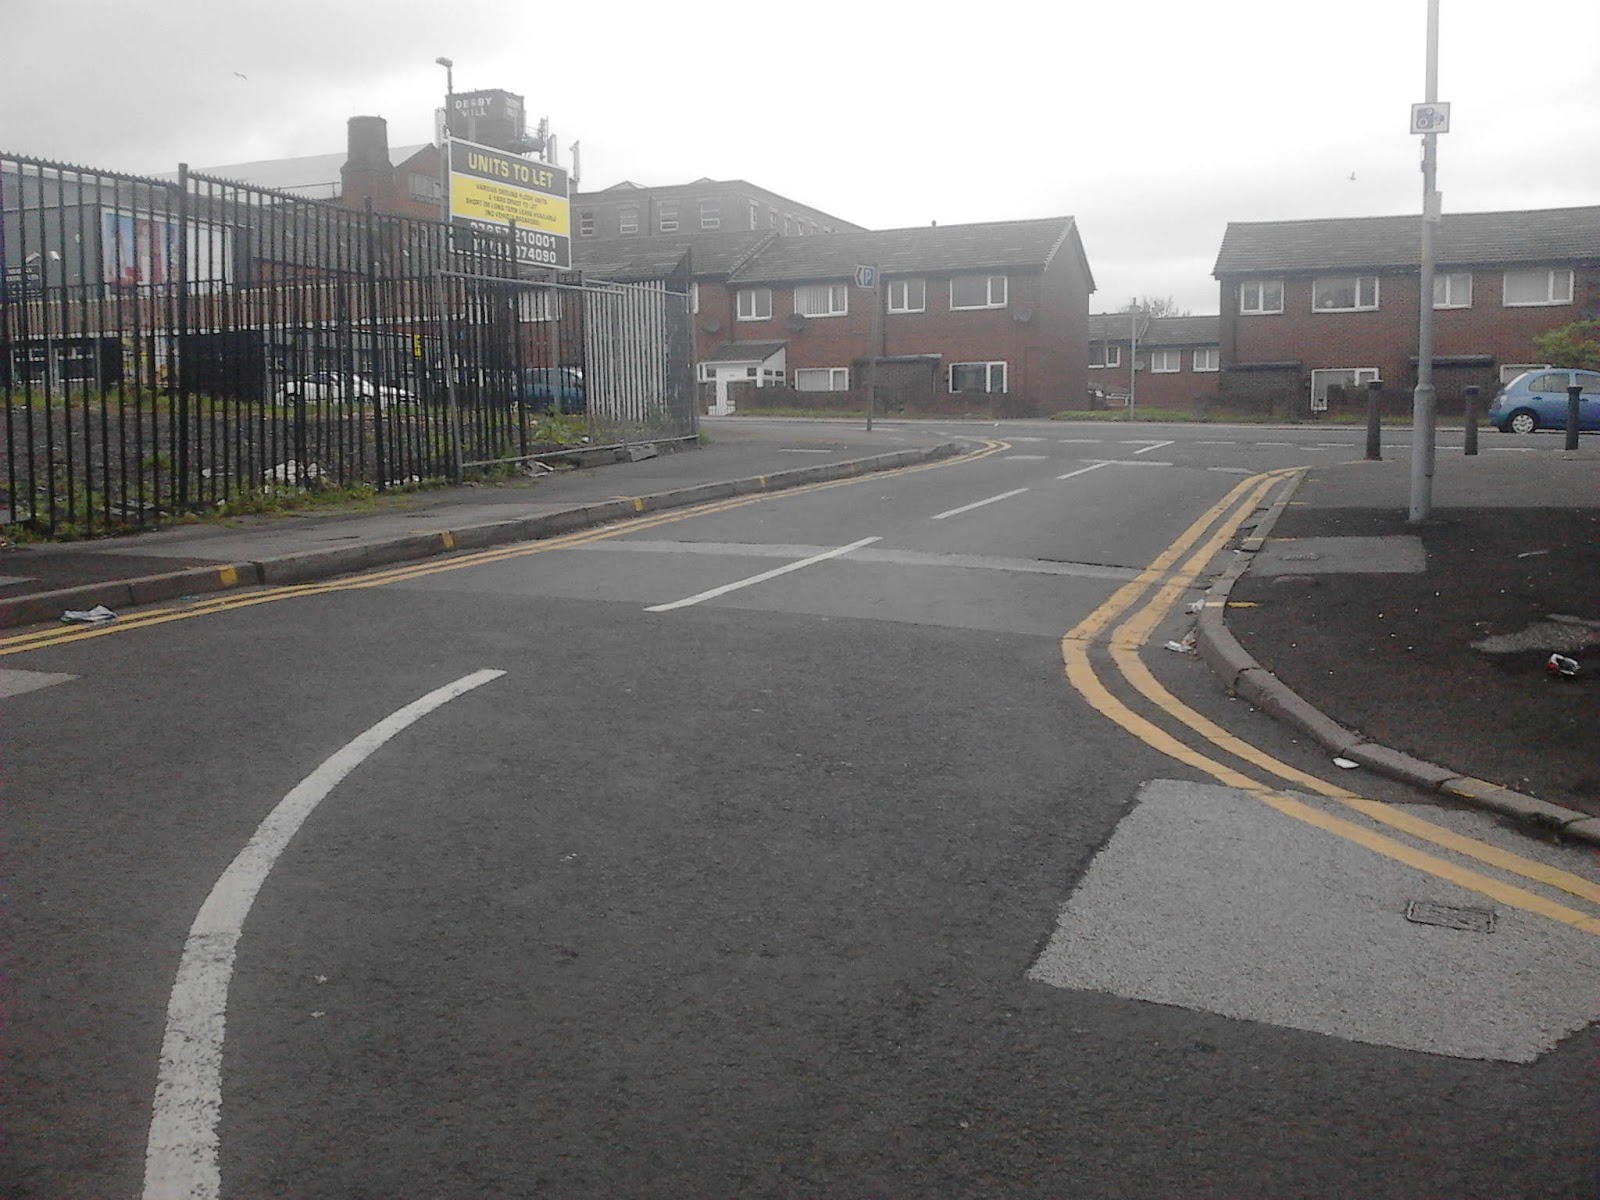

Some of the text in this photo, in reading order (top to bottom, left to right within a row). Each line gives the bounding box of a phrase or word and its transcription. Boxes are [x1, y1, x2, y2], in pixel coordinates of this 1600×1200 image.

[468, 152, 554, 188] UNITS TO LET
[865, 269, 872, 285] P
